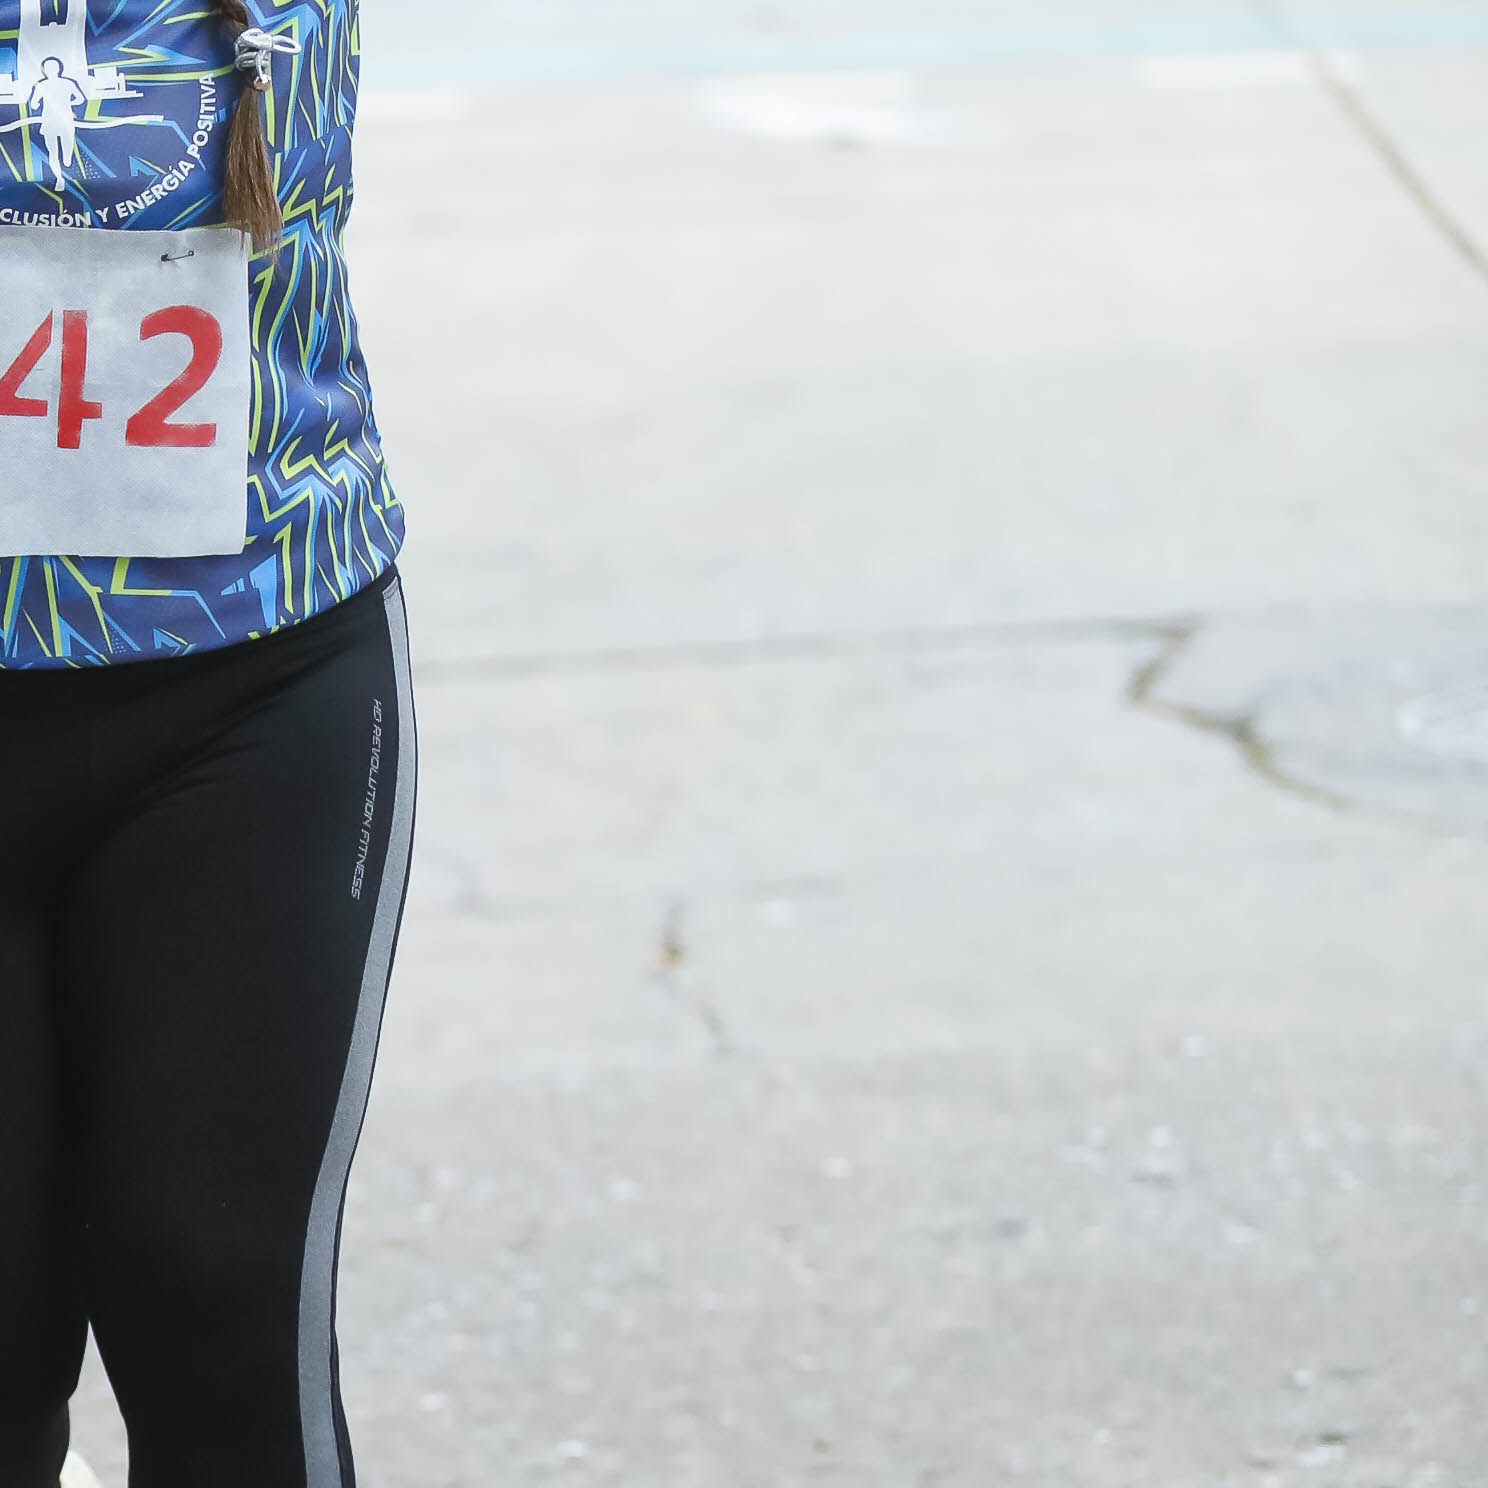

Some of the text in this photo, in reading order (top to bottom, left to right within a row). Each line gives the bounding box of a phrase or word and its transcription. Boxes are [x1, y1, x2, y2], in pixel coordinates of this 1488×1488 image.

[95, 206, 110, 223] Y
[115, 160, 195, 219] ENERGÍA
[186, 72, 217, 159] POSITIVA
[363, 723, 383, 828] REVOLUTION
[351, 829, 371, 901] FITNESS
